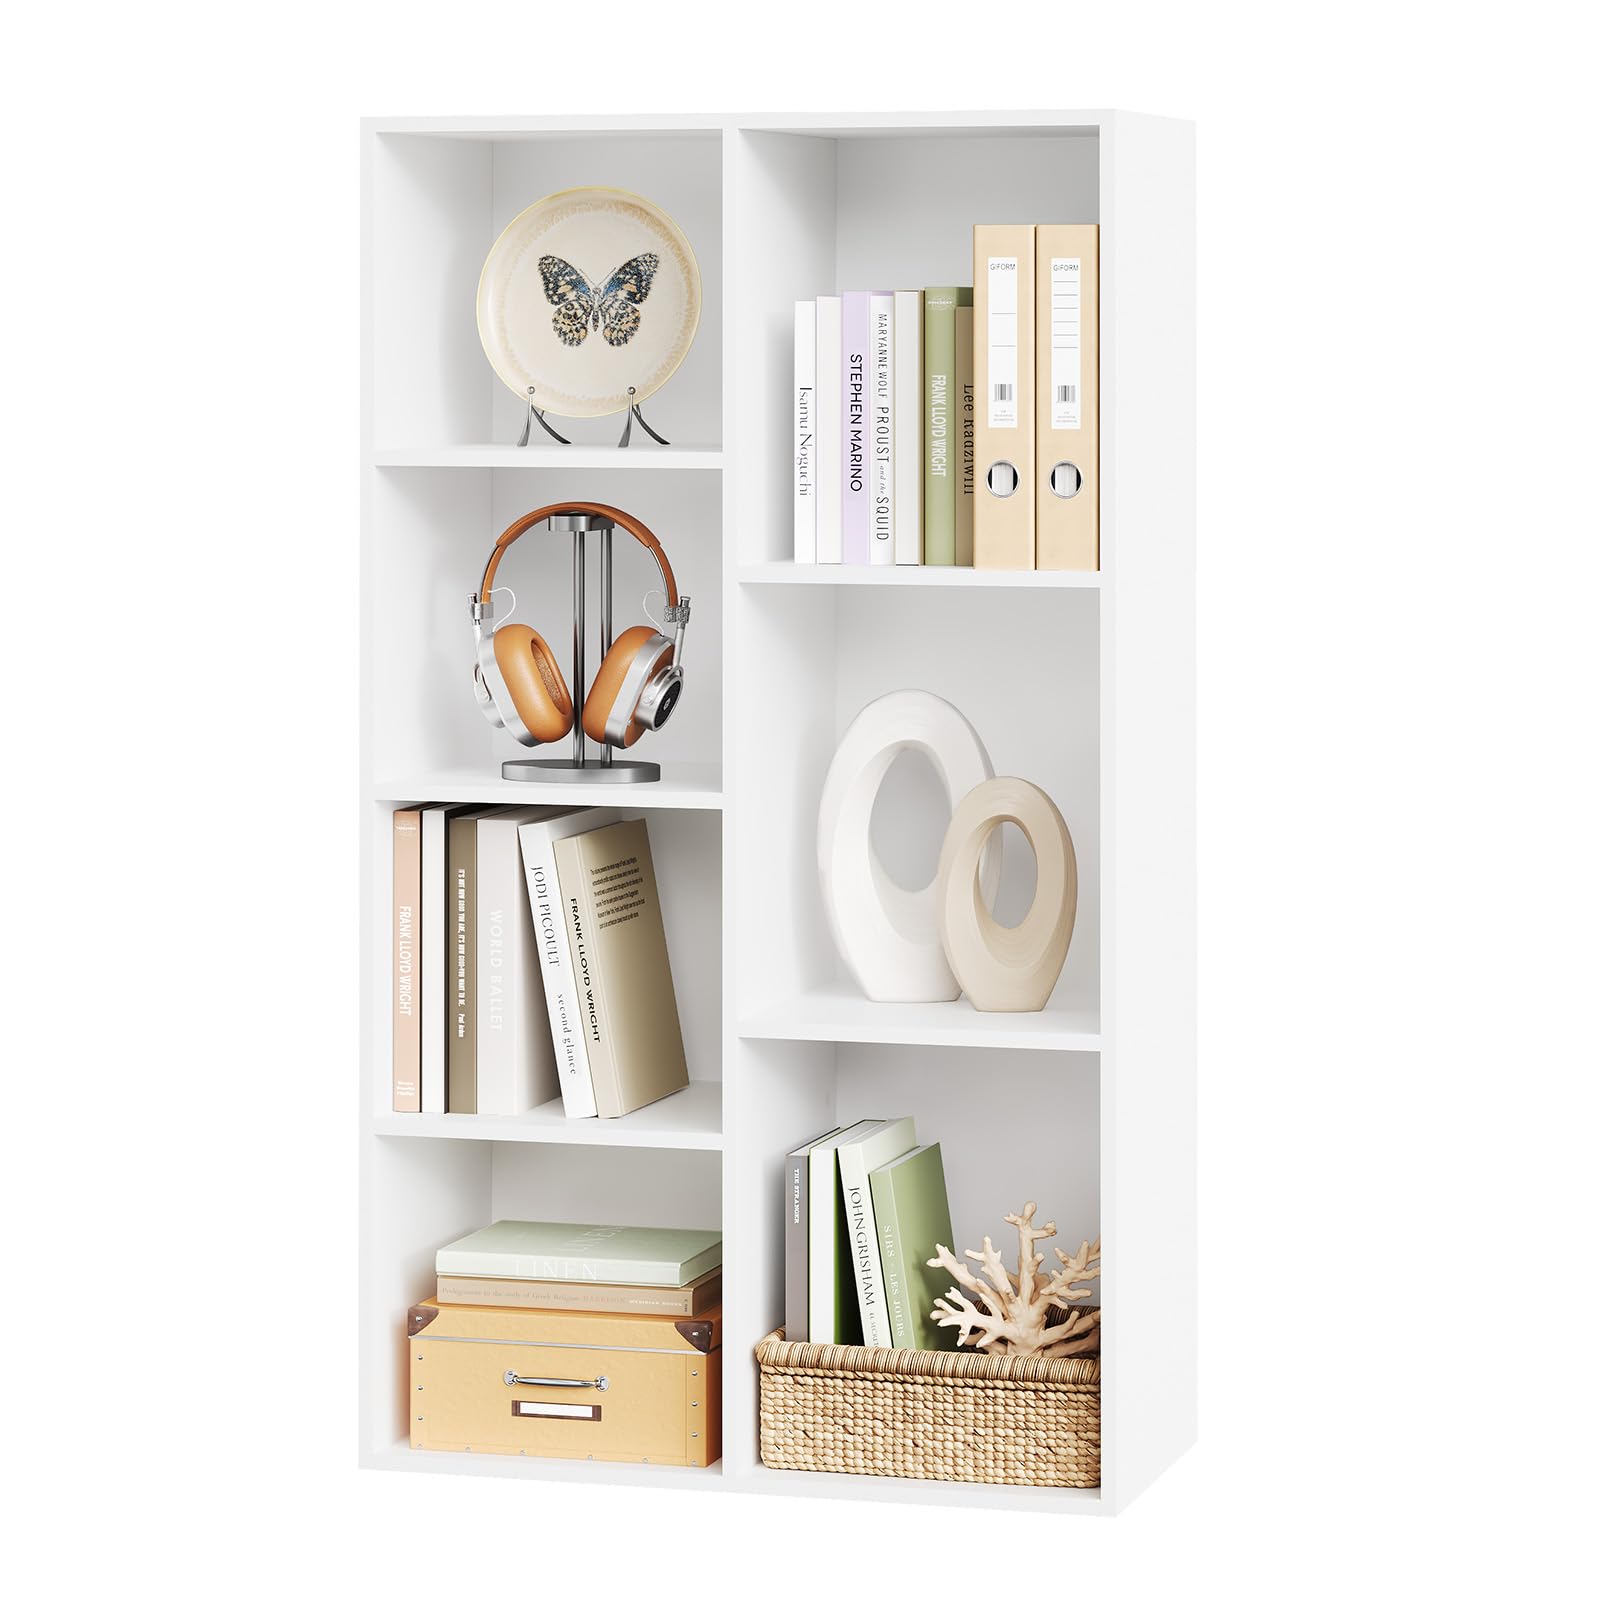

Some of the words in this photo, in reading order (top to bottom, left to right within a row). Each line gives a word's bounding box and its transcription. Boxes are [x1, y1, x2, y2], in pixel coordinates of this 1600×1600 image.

[878, 313, 889, 370] MARYANNE
[850, 353, 863, 425] STEPHEN
[878, 371, 889, 399] WOLF
[931, 375, 947, 407] FRANK
[963, 384, 975, 412] Lee
[799, 386, 813, 429] Isamu
[931, 407, 947, 438] LLOYD
[876, 406, 890, 462] PROUST
[796, 433, 813, 496] Noguchi
[850, 429, 863, 492] MARINO
[879, 465, 887, 480] and
[931, 439, 947, 477] WRIGHT
[879, 482, 887, 495] the
[876, 496, 890, 541] SQUID
[399, 906, 413, 939] FRANK
[530, 865, 548, 900] JODI
[539, 903, 561, 968] PICOULT
[399, 940, 413, 974] LLOYD
[489, 909, 504, 968] WORLD
[570, 898, 583, 941] FRANK
[577, 944, 592, 987] LLOYD
[585, 989, 601, 1044] WRIGHT
[399, 975, 413, 1016] WRIGHT
[489, 975, 504, 1033] BALLET
[556, 993, 573, 1035] second
[562, 1037, 578, 1075] glance
[883, 1225, 896, 1258] SIRS
[889, 1273, 900, 1295] LES
[892, 1300, 905, 1338] JOURS
